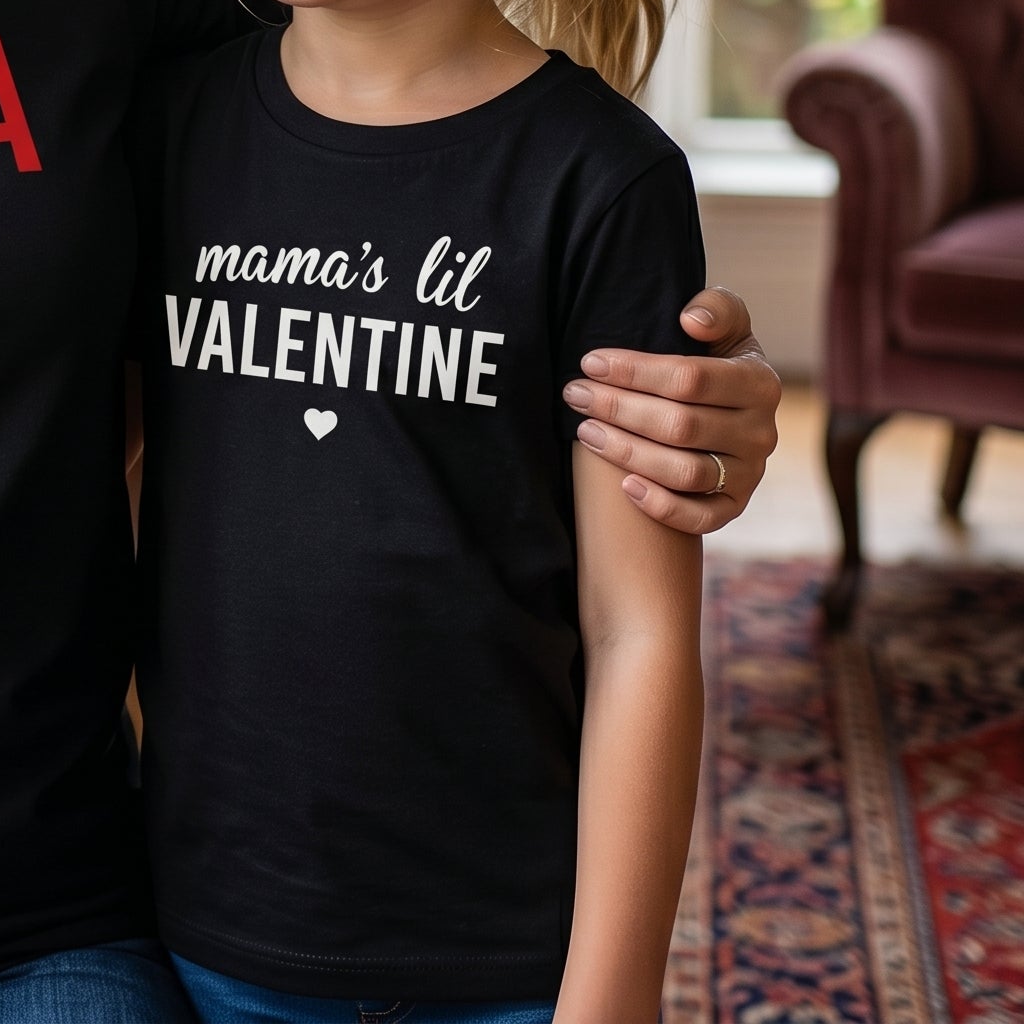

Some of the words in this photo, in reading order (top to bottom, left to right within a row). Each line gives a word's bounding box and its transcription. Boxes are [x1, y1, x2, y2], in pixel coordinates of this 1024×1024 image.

[195, 242, 389, 293] mama's
[416, 236, 492, 312] lil
[165, 294, 505, 408] VALENTINE
